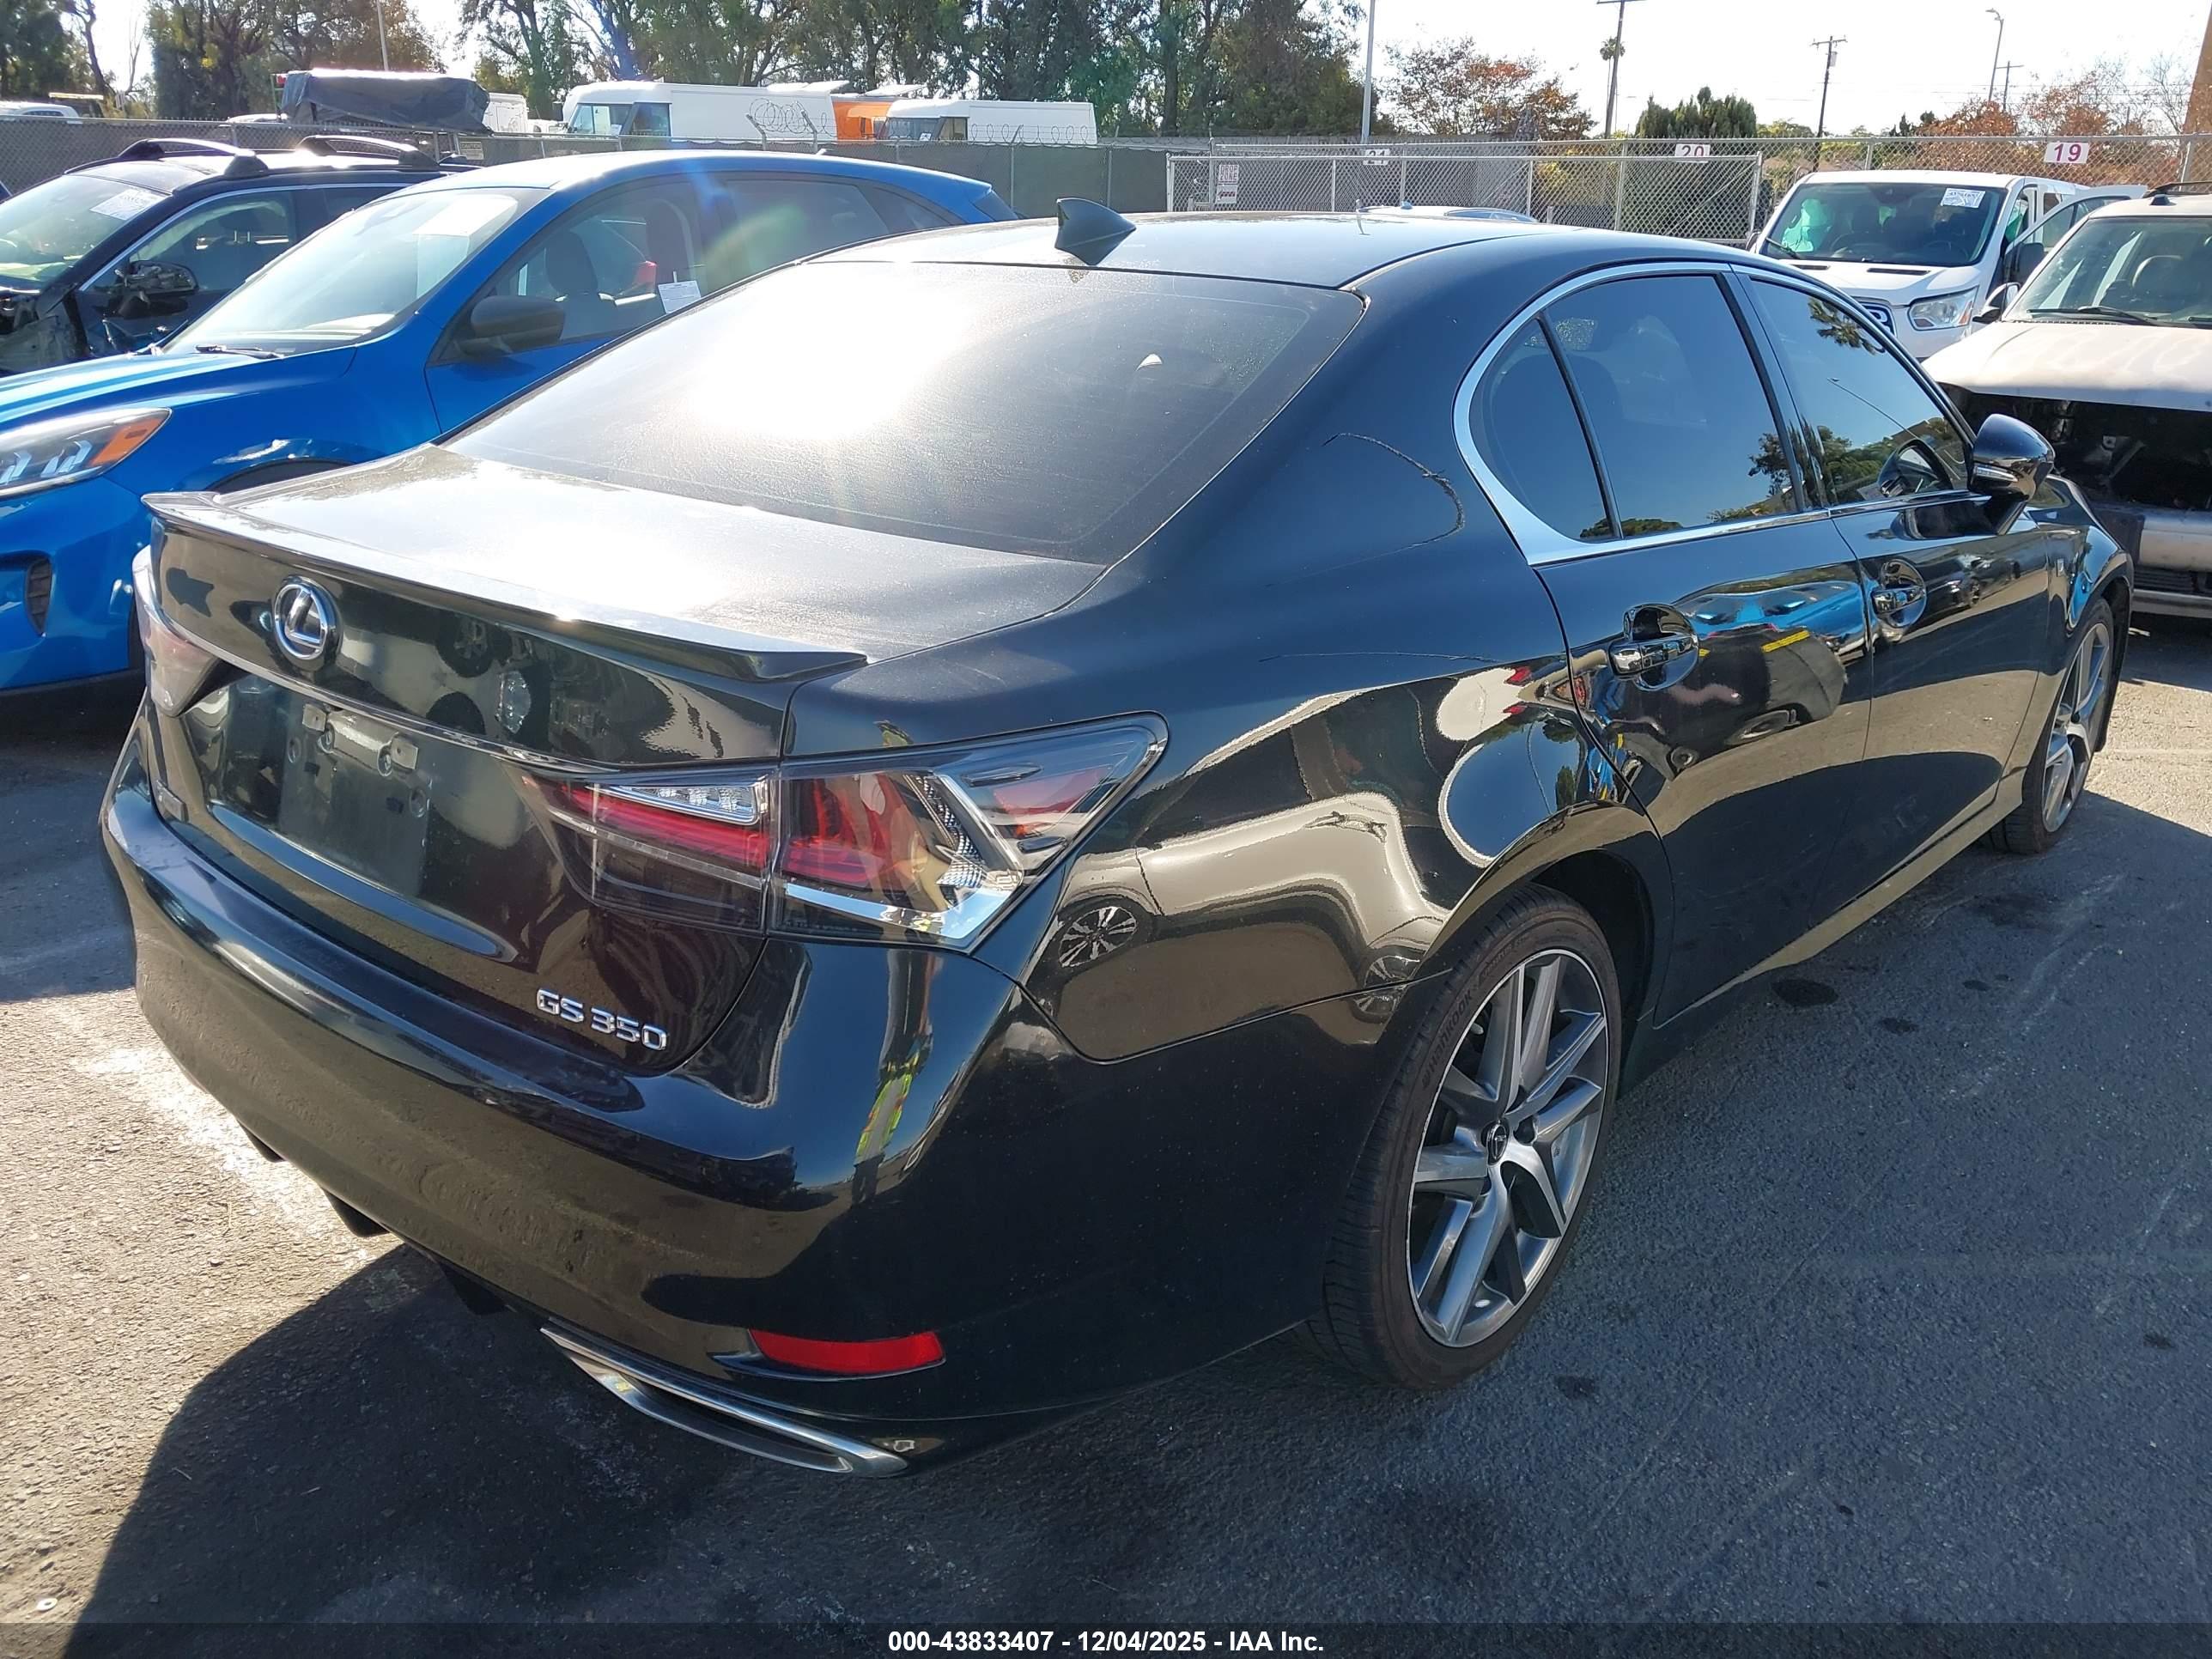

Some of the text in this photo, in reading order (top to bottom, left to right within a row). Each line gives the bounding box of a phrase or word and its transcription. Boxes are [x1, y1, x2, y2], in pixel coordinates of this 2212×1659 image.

[2054, 143, 2081, 162] 19
[537, 989, 667, 1050] GS 350
